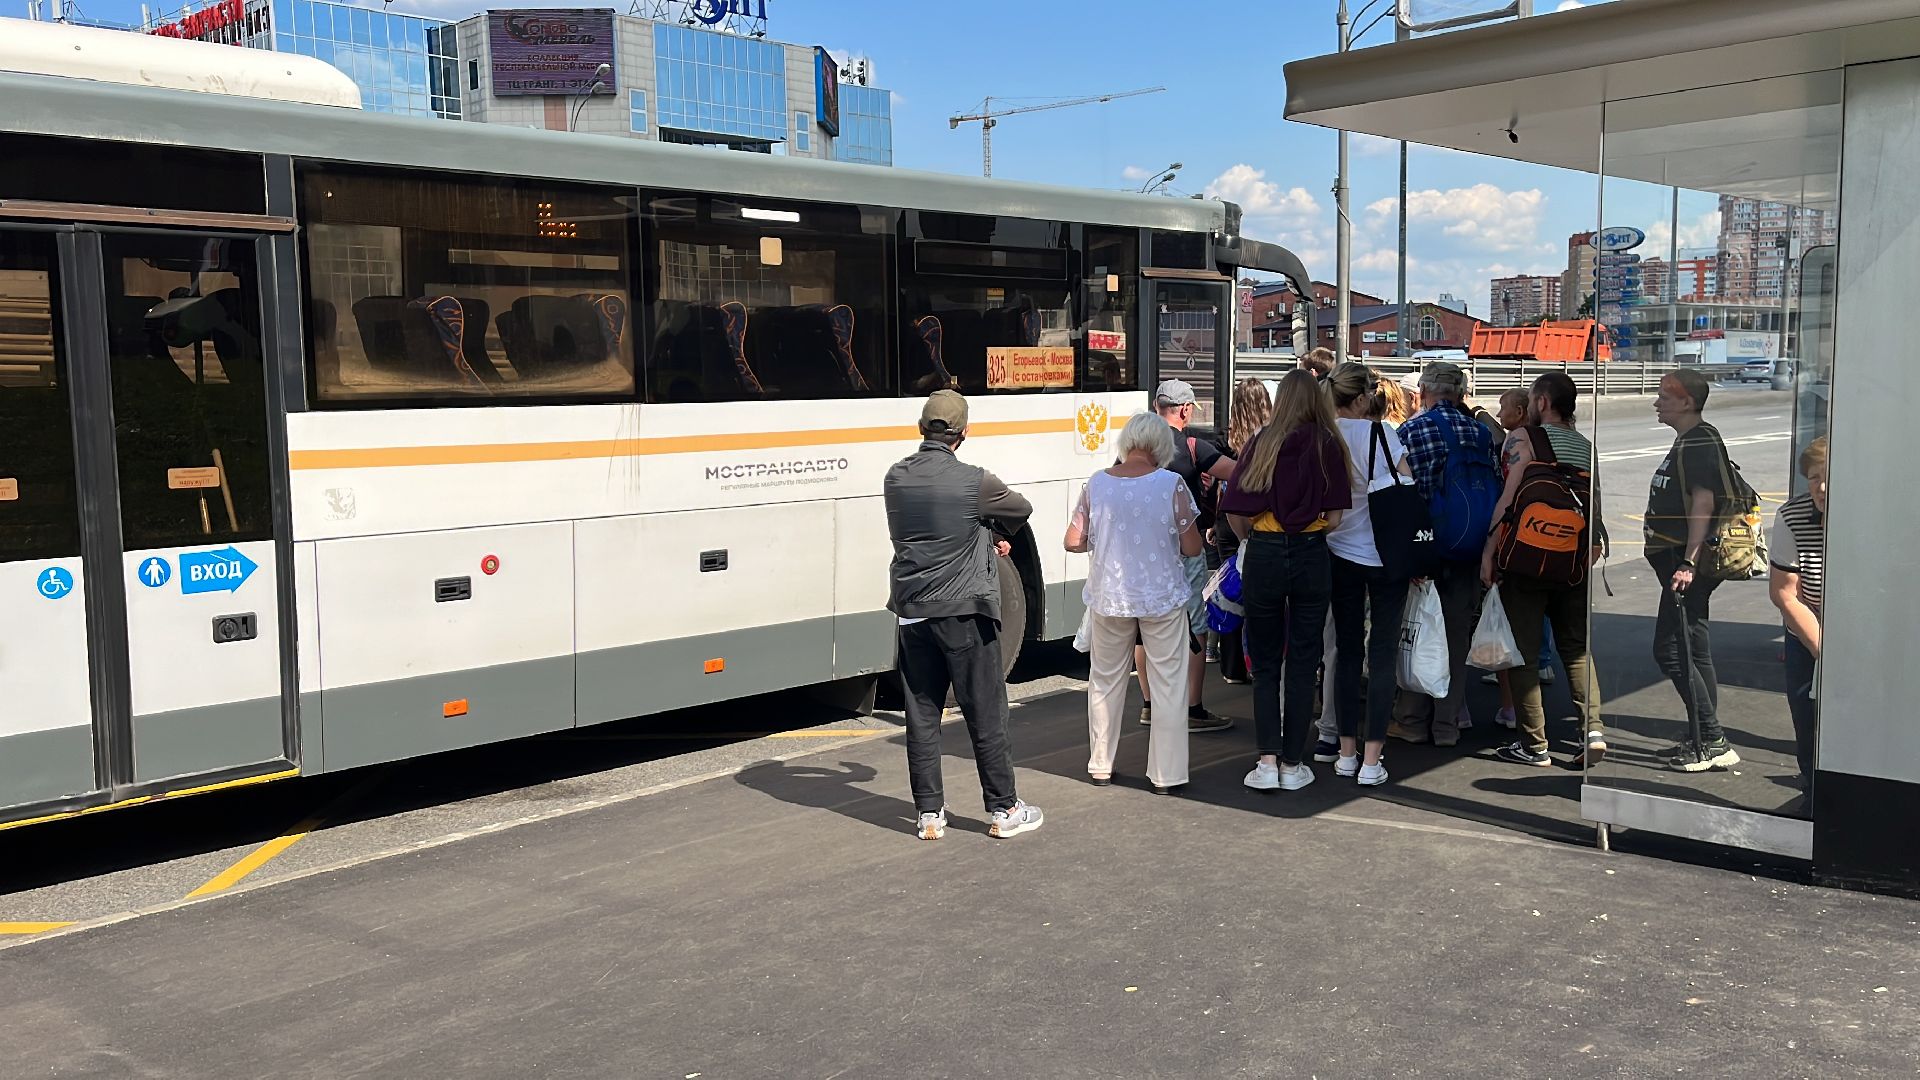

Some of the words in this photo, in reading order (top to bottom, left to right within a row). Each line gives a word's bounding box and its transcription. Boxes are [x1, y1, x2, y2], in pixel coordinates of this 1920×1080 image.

[988, 355, 1006, 385] 325
[1013, 353, 1046, 369] Егорьевск
[1051, 353, 1073, 367] Москва
[1012, 371, 1020, 385] (с
[1021, 370, 1073, 383] остановками)
[705, 457, 849, 480] МОСТРАНСАВТО
[190, 560, 243, 582] ВХОД
